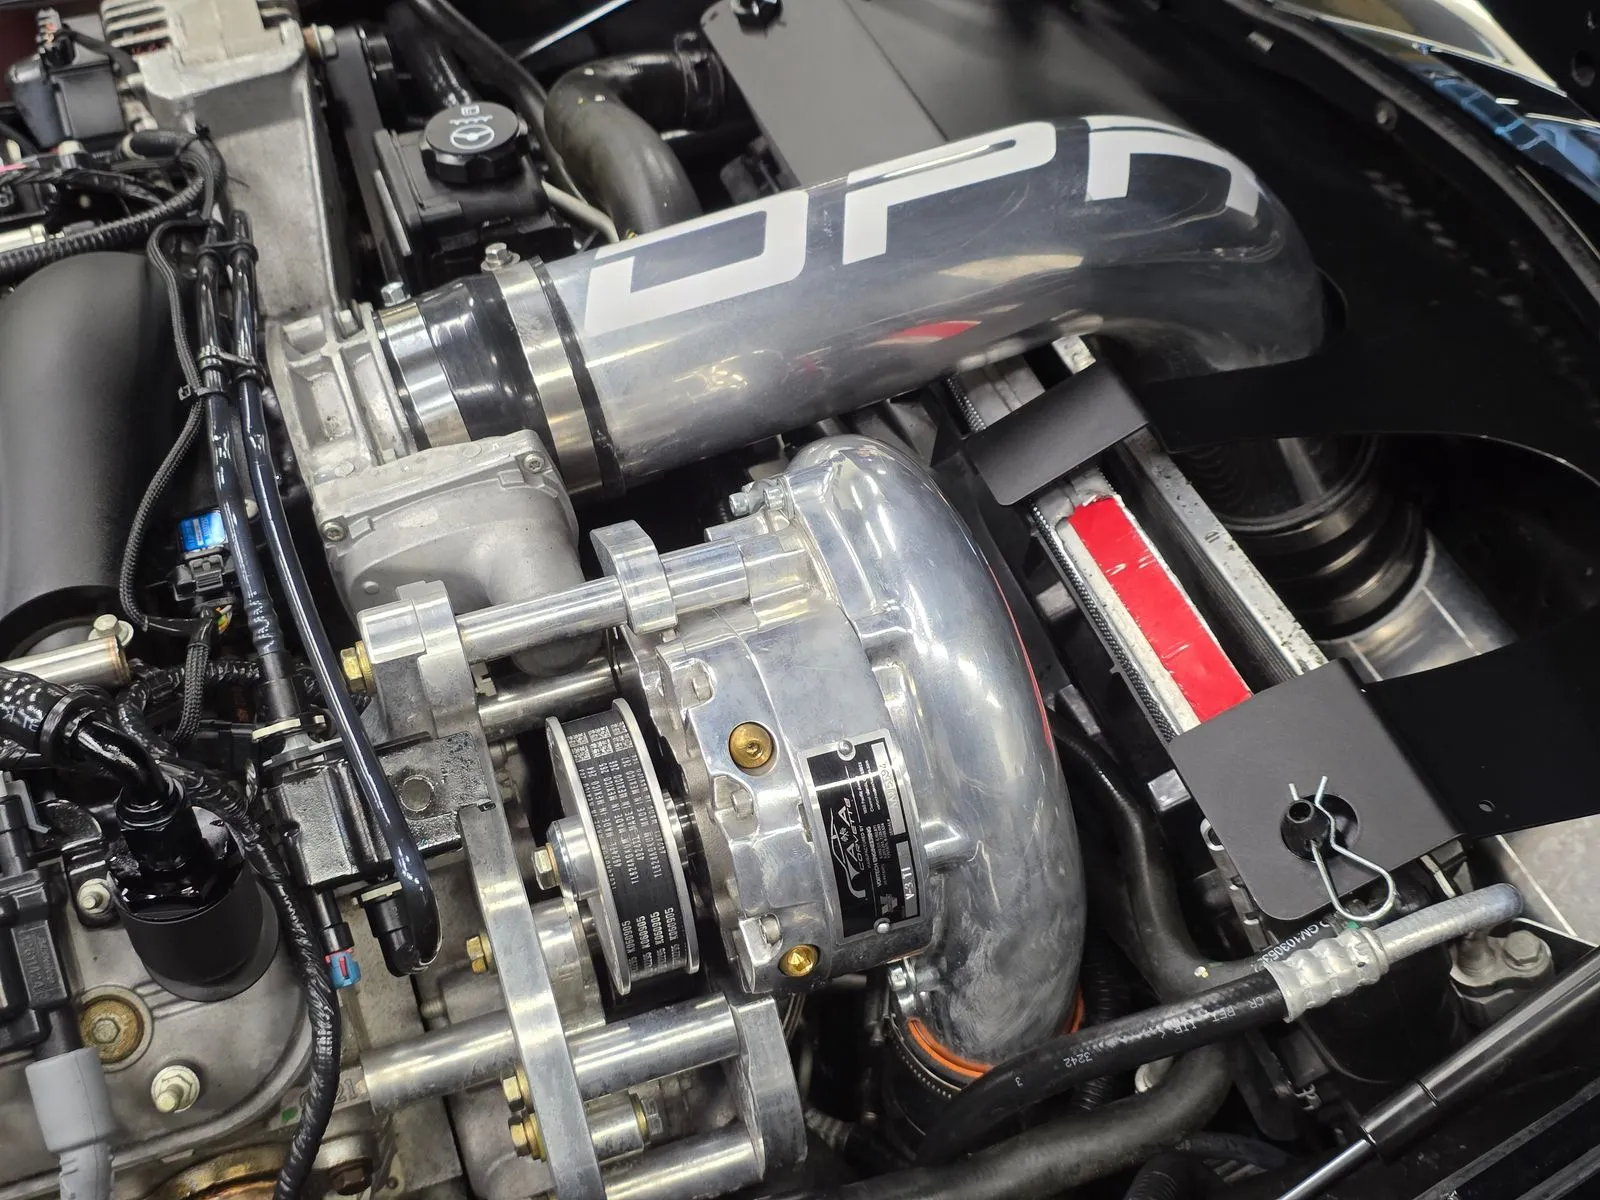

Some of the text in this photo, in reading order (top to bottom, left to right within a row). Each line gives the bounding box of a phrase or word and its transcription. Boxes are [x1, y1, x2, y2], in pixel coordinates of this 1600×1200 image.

[589, 779, 605, 805] MEXICO
[602, 776, 617, 801] MEXICO
[612, 773, 627, 798] MEXICO
[625, 769, 640, 794] MEXICO
[598, 806, 607, 816] IN
[610, 802, 619, 811] IN
[620, 799, 630, 809] IN
[636, 806, 649, 826] MADE
[601, 817, 614, 837] MADE
[613, 813, 626, 833] MADE
[623, 810, 637, 831] MADE
[842, 795, 865, 871] CORVETTE
[635, 914, 651, 948] K060905
[649, 910, 664, 944] K060905
[663, 906, 678, 940] K060905
[621, 919, 636, 953] K060905
[1063, 1051, 1093, 1069] 3242
